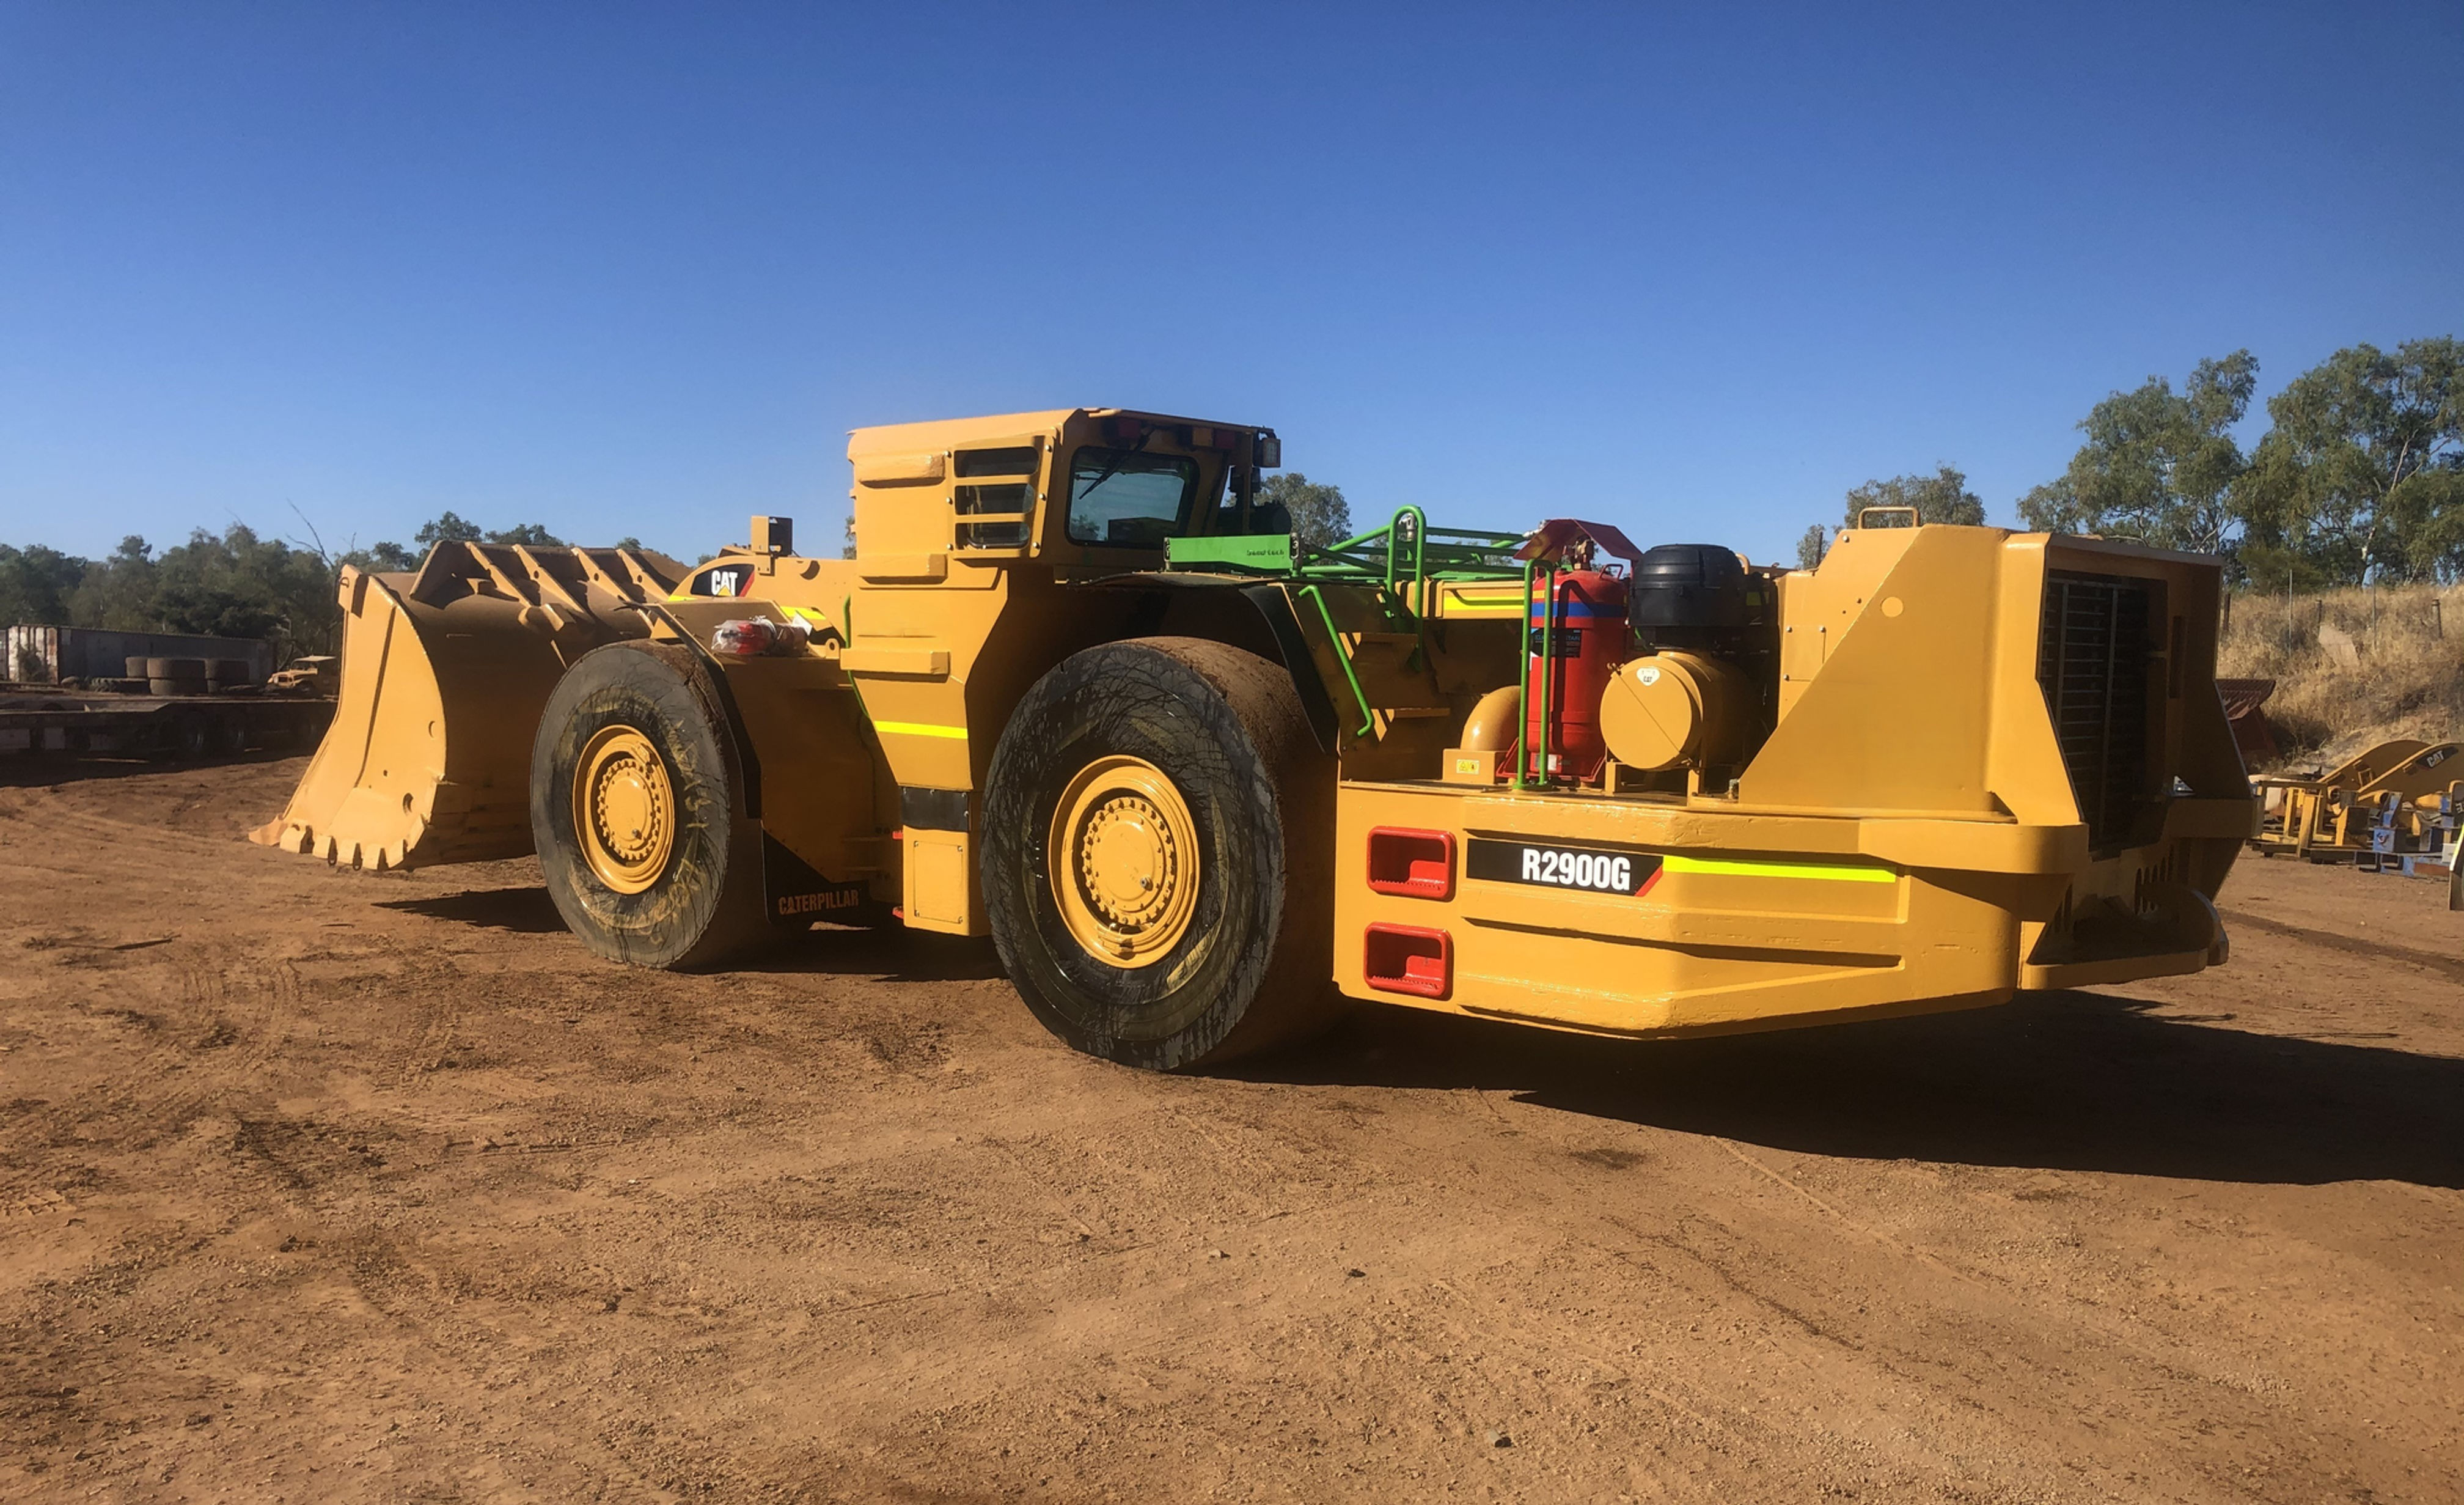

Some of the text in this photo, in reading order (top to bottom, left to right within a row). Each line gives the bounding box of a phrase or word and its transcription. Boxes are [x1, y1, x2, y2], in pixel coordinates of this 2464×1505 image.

[711, 570, 738, 596] CAT
[2427, 750, 2444, 767] CAT
[1522, 848, 1630, 891] R2900G
[778, 889, 859, 915] CATERPILLAR
